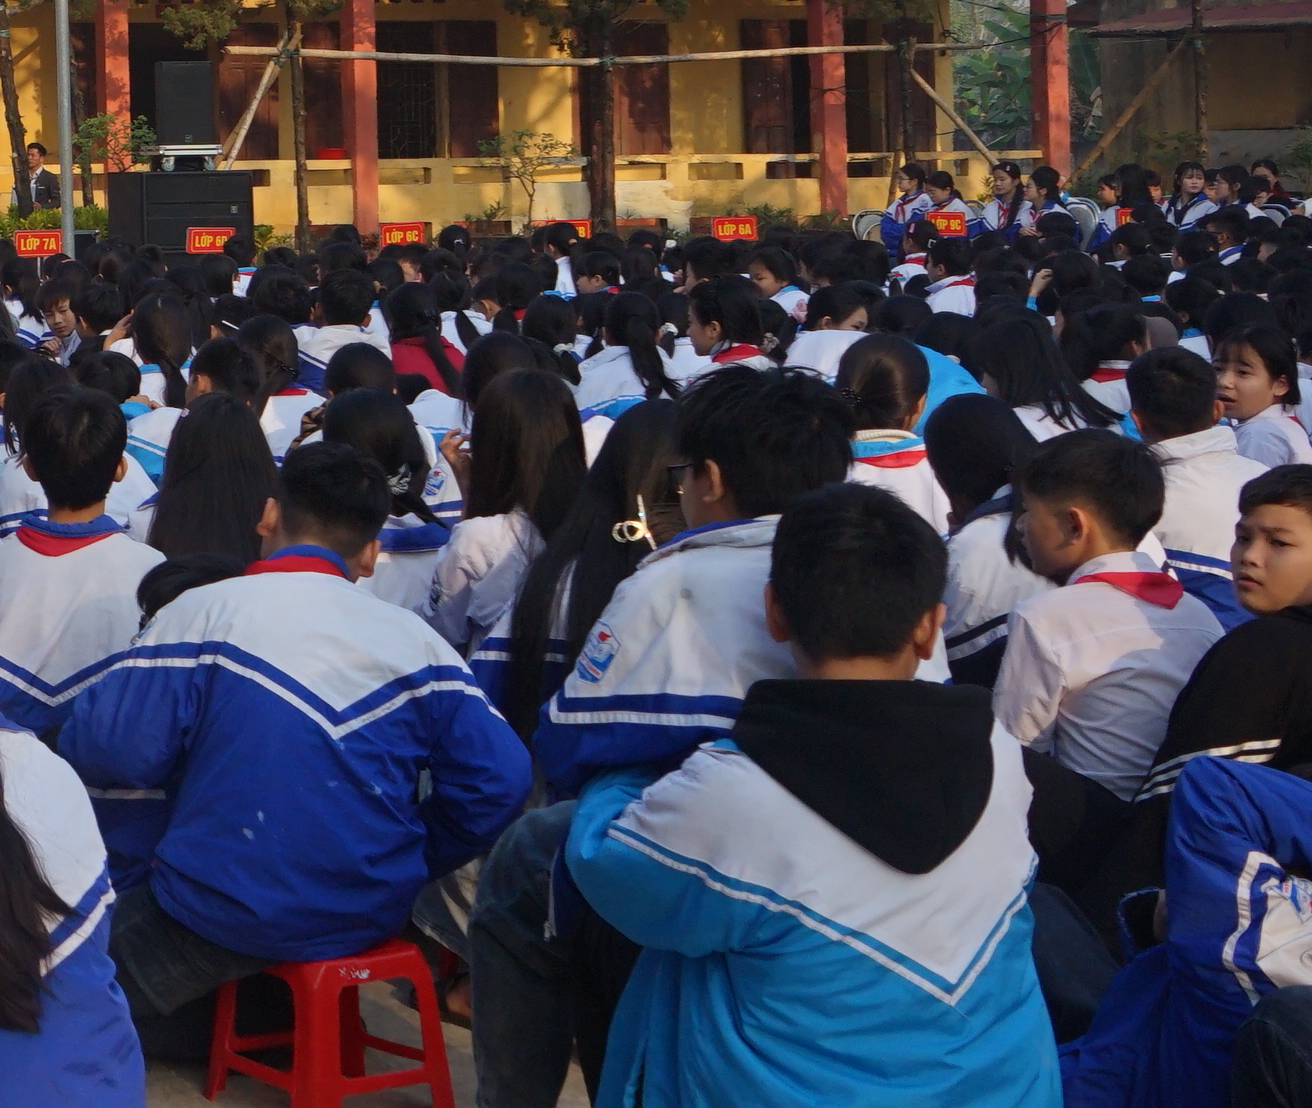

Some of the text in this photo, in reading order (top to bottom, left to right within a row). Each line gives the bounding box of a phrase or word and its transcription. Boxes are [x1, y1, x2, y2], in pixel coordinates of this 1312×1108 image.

[717, 220, 751, 236] LỚP 6A
[949, 219, 962, 230] 9C
[20, 234, 56, 251] LỚP 7A
[195, 230, 211, 248] LỚP
[386, 226, 418, 244] LỚP 6C
